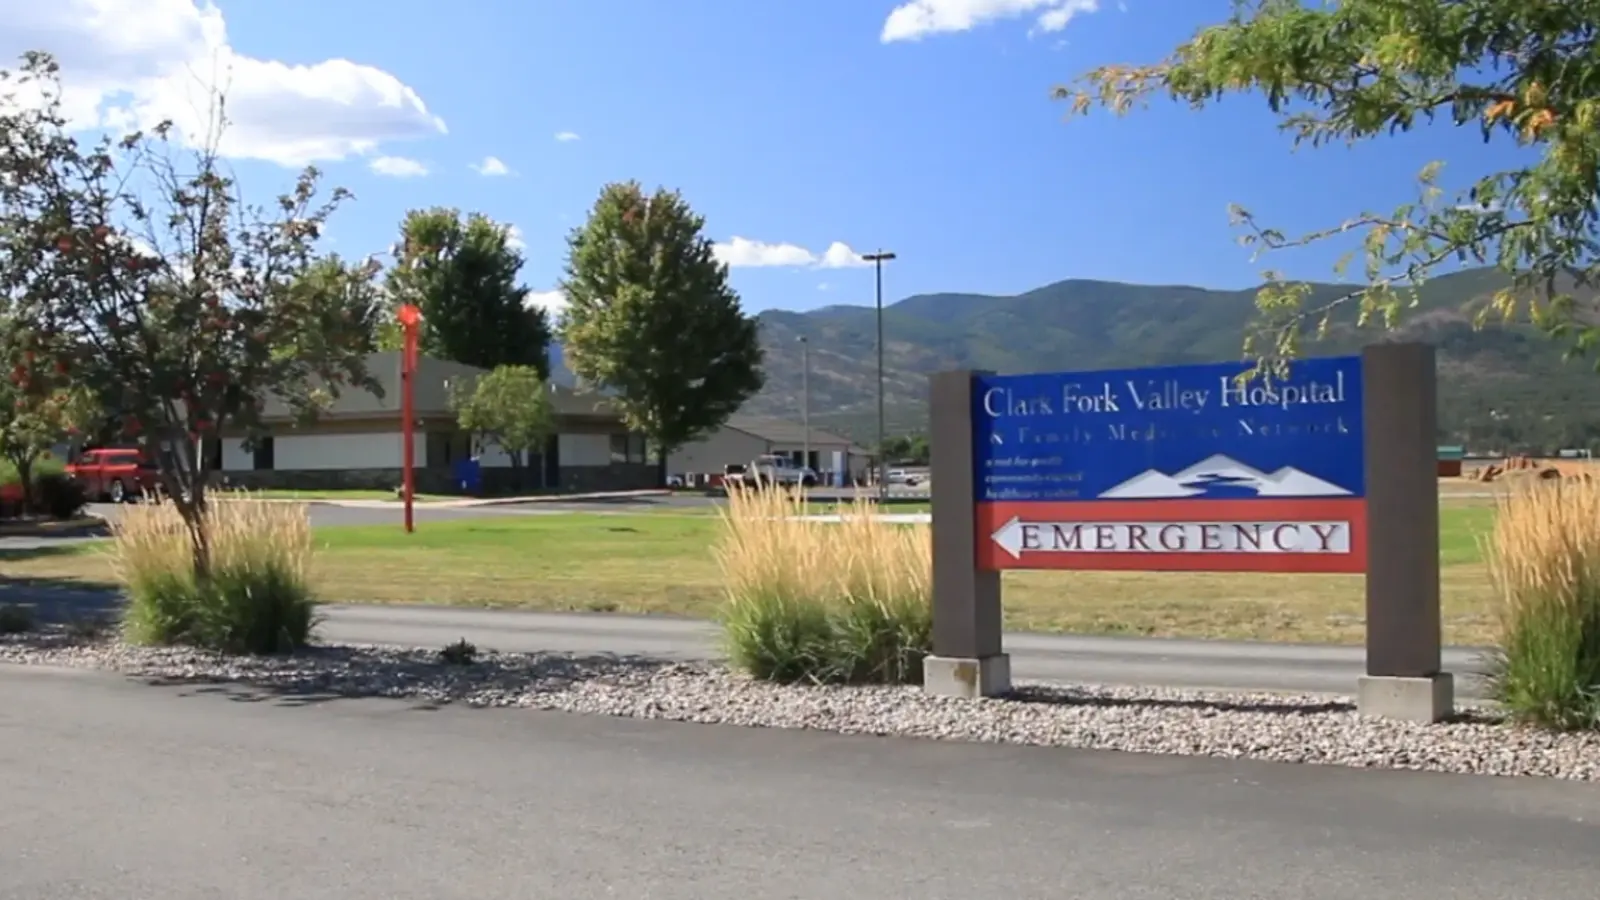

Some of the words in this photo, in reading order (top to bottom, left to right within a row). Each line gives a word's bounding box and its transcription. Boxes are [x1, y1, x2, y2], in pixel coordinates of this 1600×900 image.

[983, 387, 1053, 417] Clark
[1062, 383, 1120, 413] Fork
[1127, 380, 1209, 414] Valley
[1220, 371, 1345, 411] Hospital
[1108, 422, 1219, 441] Medie
[1021, 524, 1339, 551] EMERGENCY
